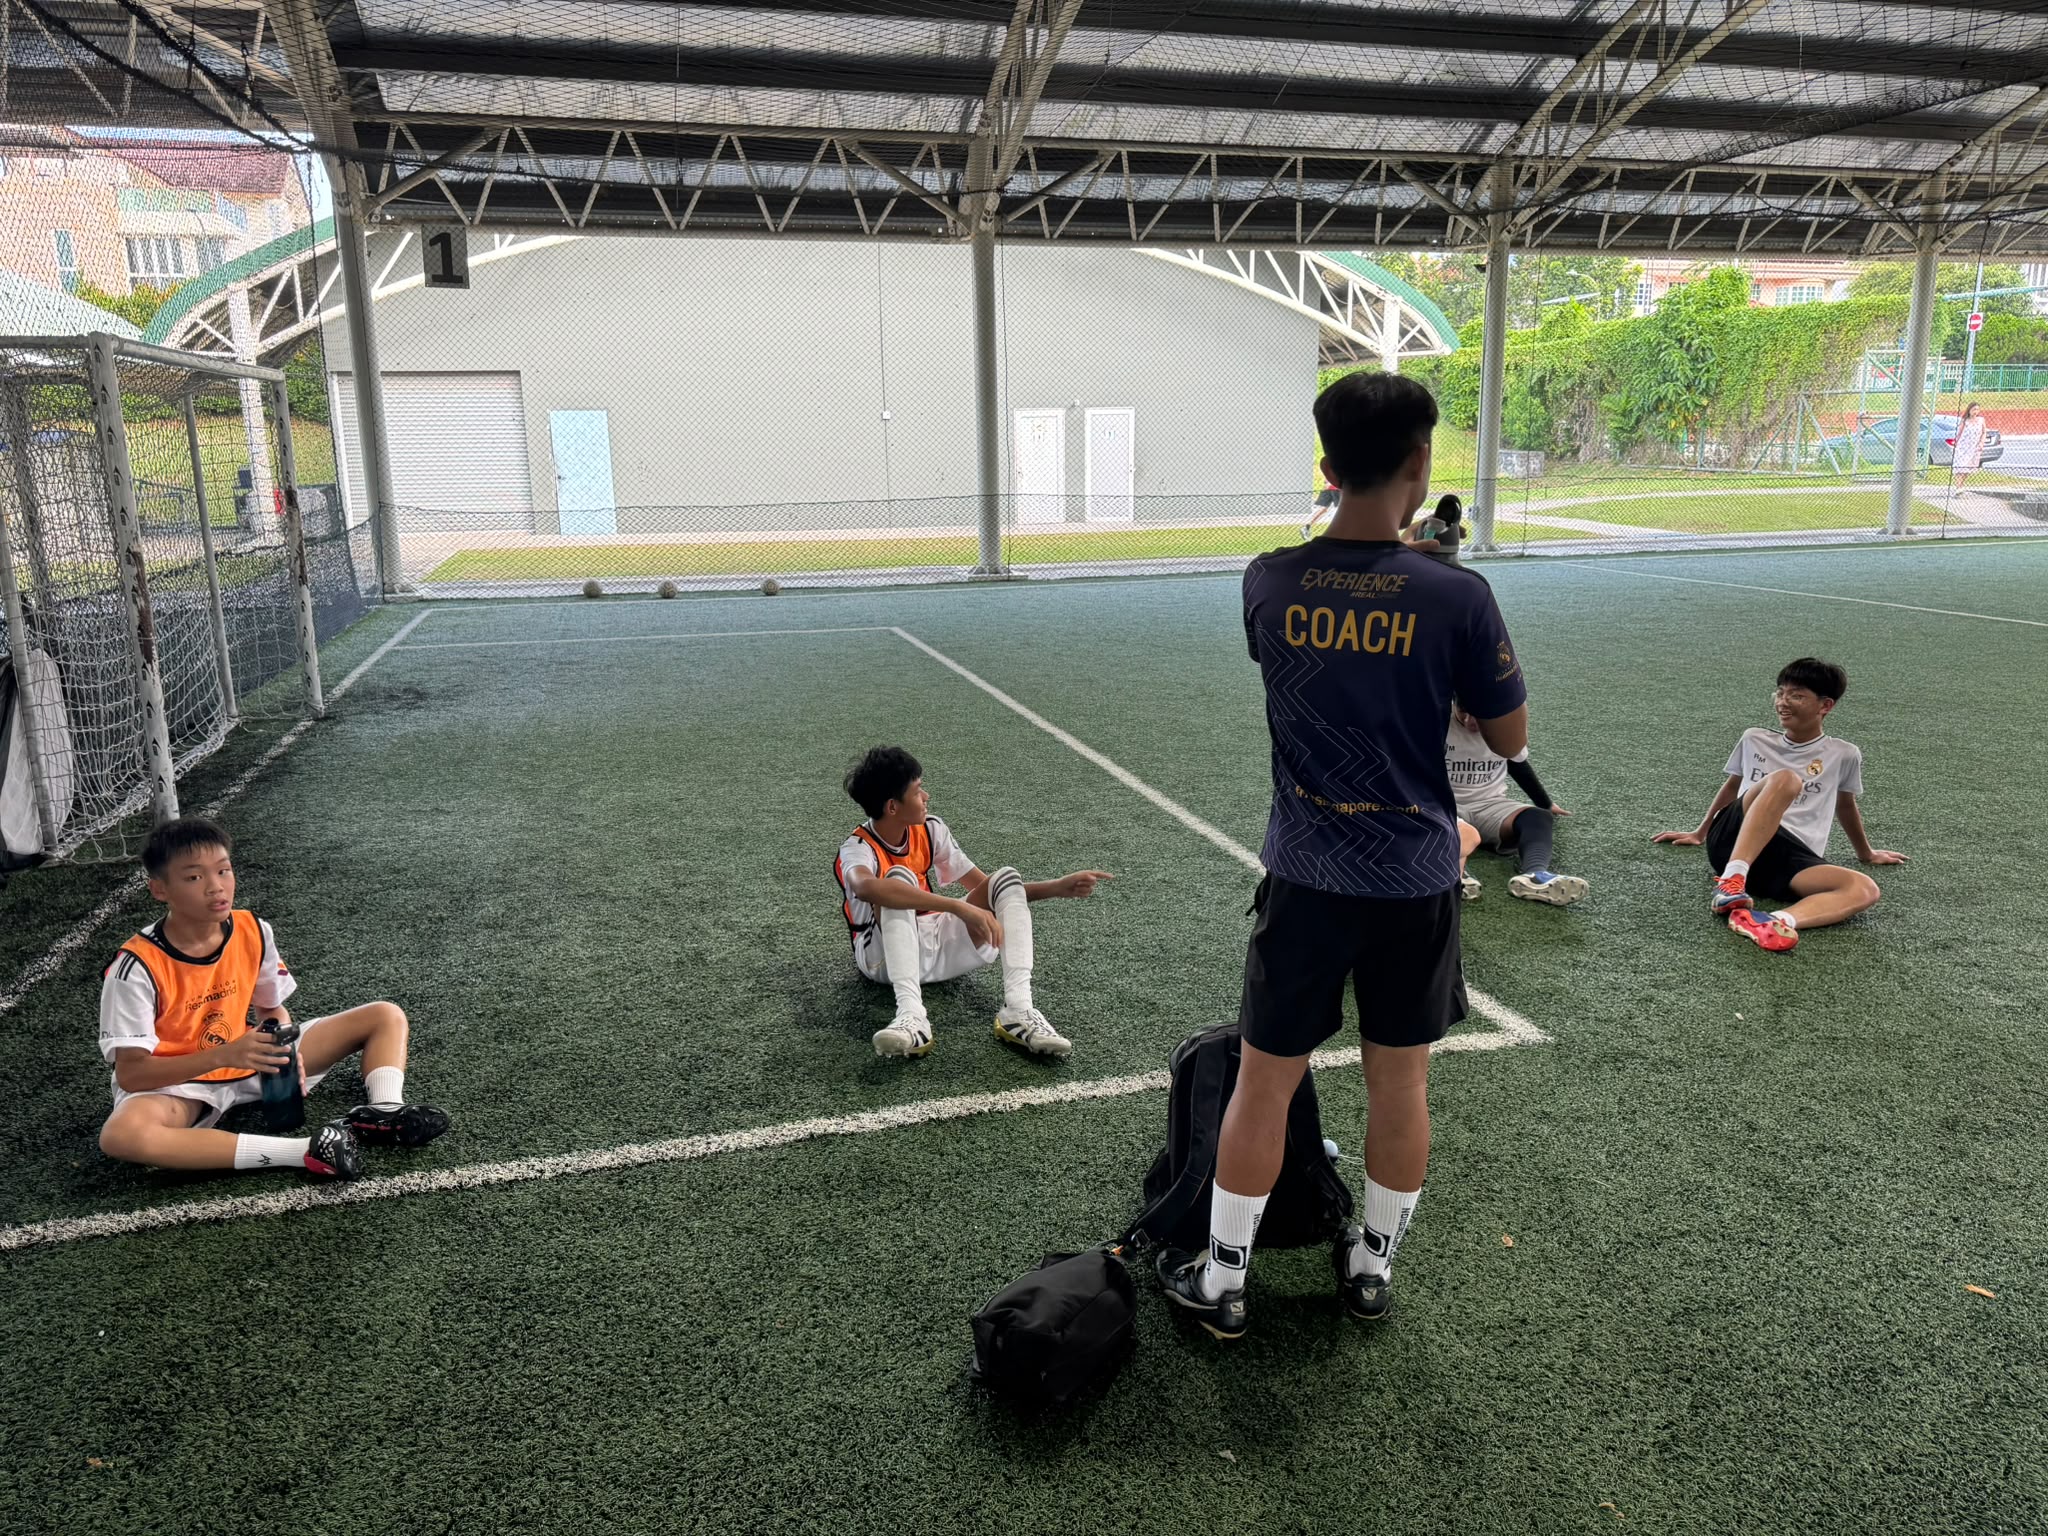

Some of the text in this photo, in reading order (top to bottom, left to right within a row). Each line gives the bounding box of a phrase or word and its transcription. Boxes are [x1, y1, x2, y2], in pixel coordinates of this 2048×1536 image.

[429, 232, 464, 283] 1
[1301, 568, 1409, 592] EXPERIENCE
[1285, 604, 1417, 657] COACH
